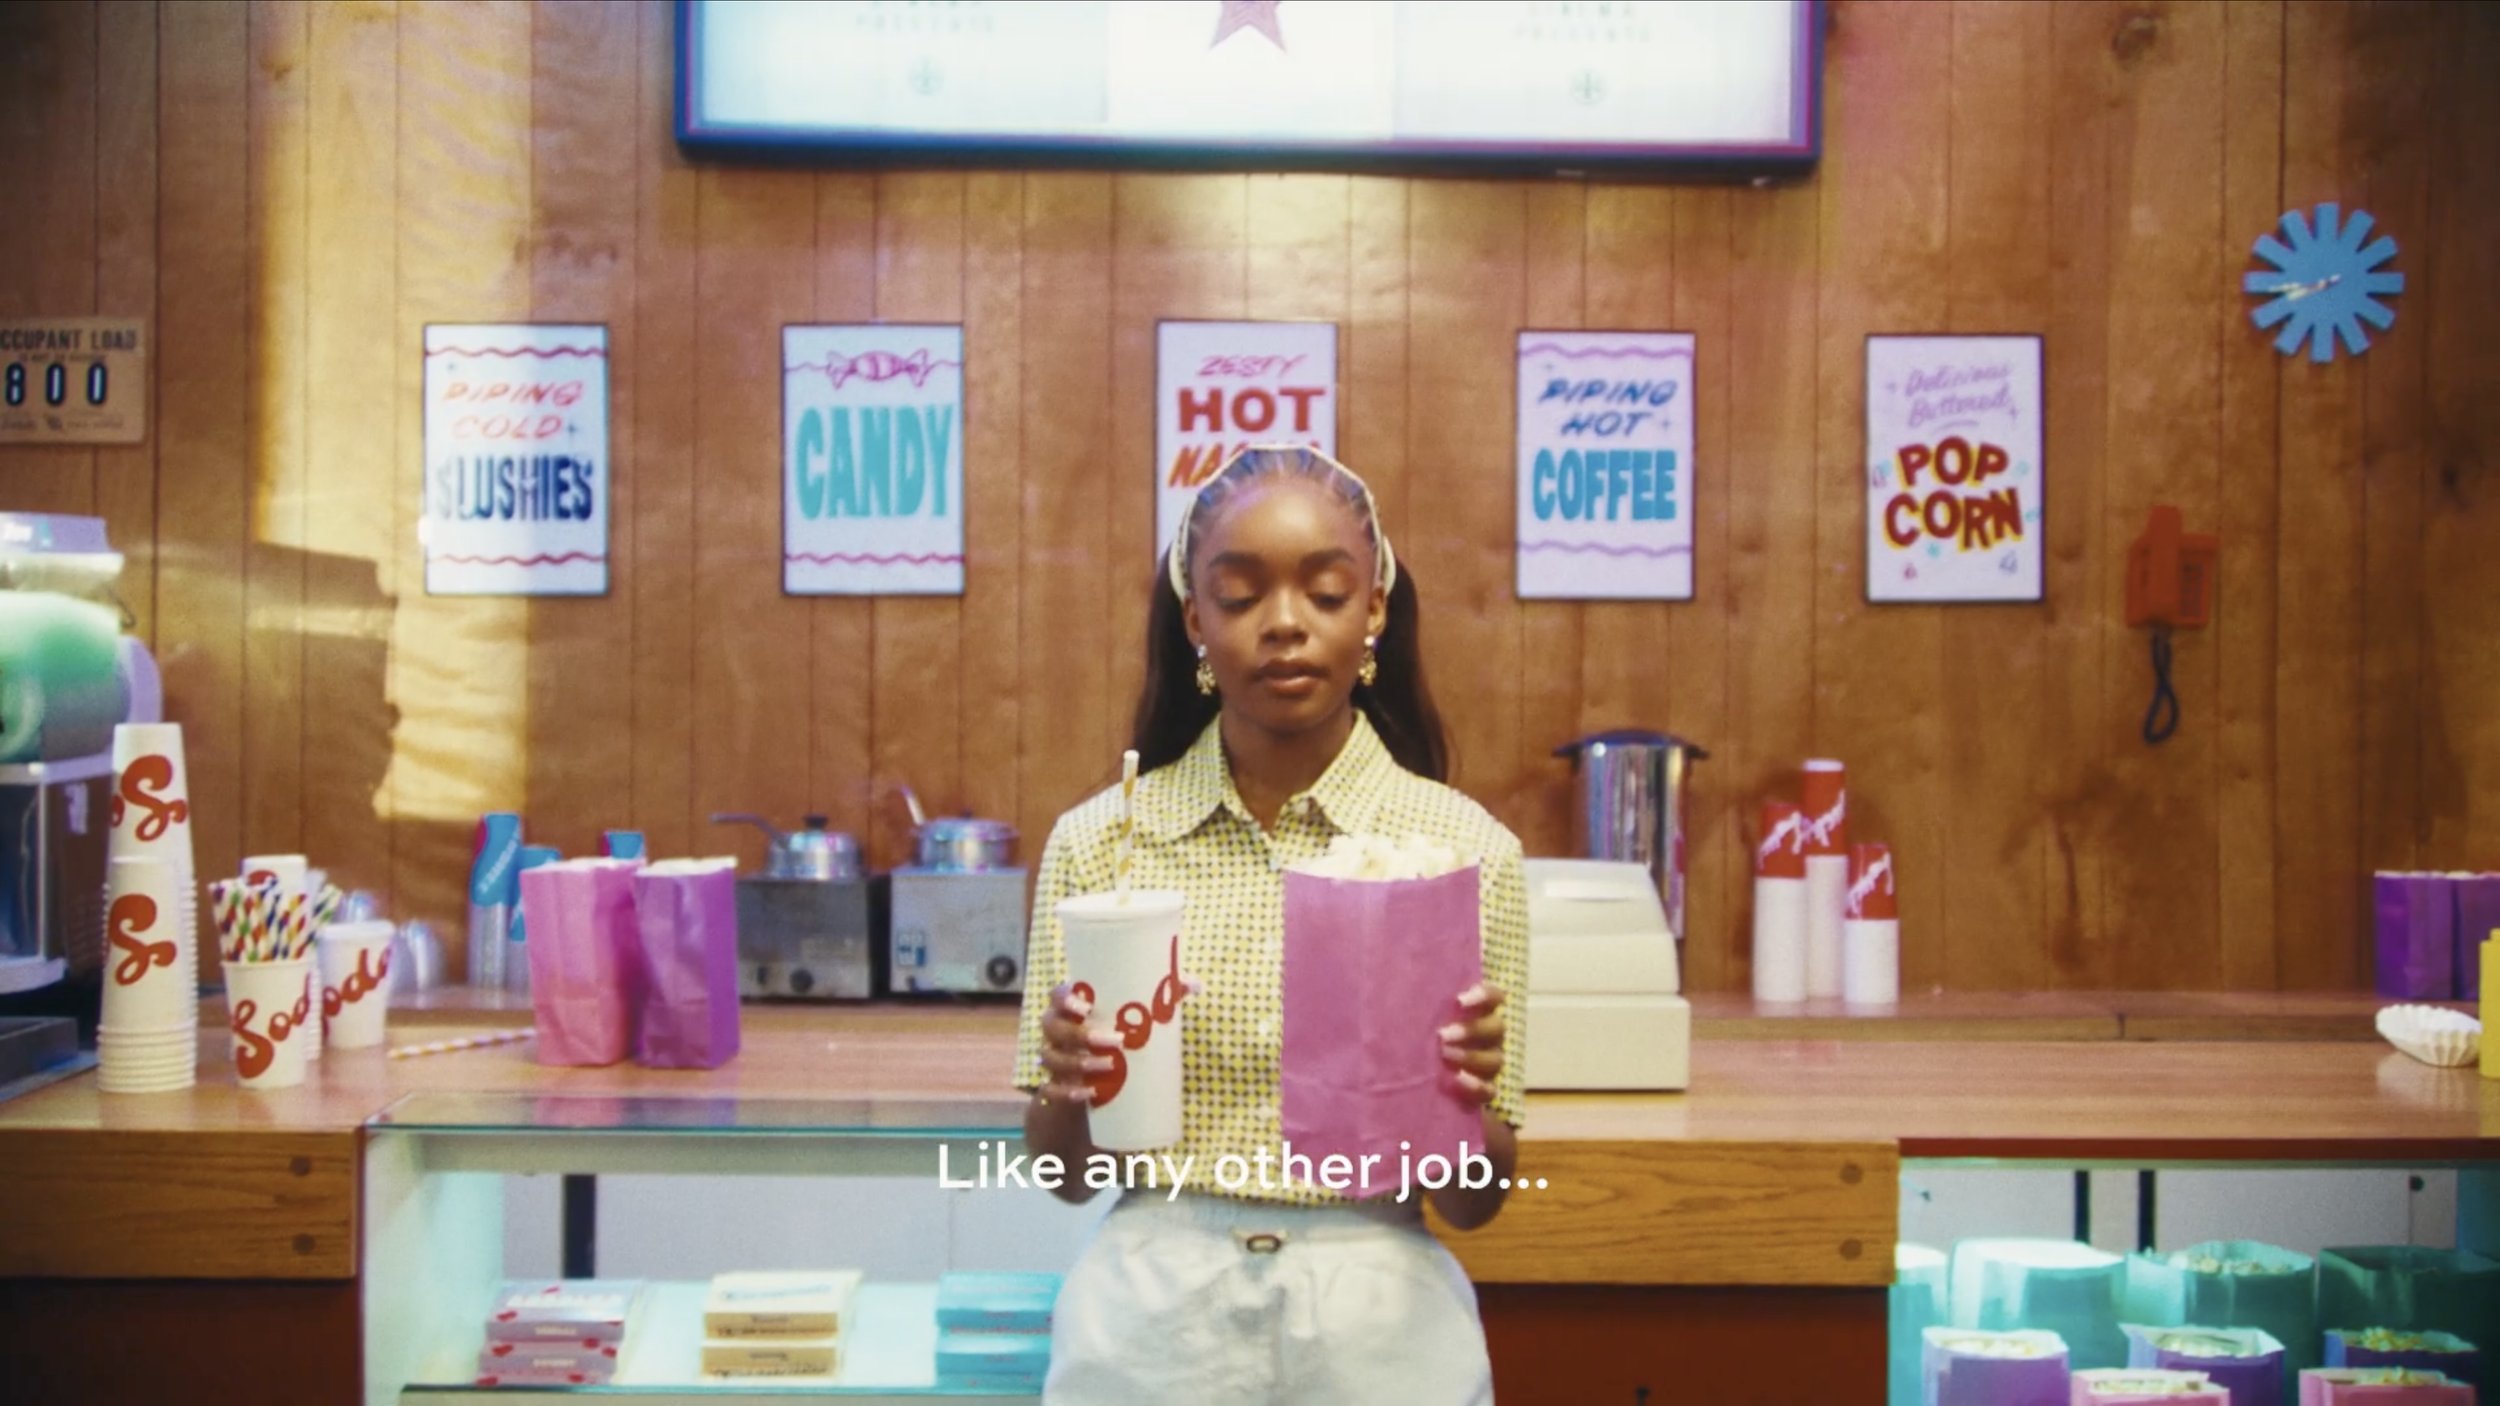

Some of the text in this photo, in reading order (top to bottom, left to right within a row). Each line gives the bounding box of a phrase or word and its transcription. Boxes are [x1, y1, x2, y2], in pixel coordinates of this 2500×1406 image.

[1197, 354, 1308, 378] ZESTY
[441, 380, 585, 408] PIPING
[1177, 386, 1327, 433] HOT
[1537, 378, 1677, 407] PIPING
[452, 414, 564, 440] COLD
[1560, 411, 1652, 438] HOT
[799, 405, 953, 520] CANDY
[1532, 448, 1677, 521] COFFEE
[1894, 435, 2010, 492] POP
[437, 455, 593, 521] SLUSHIES
[1882, 487, 2025, 553] CORN
